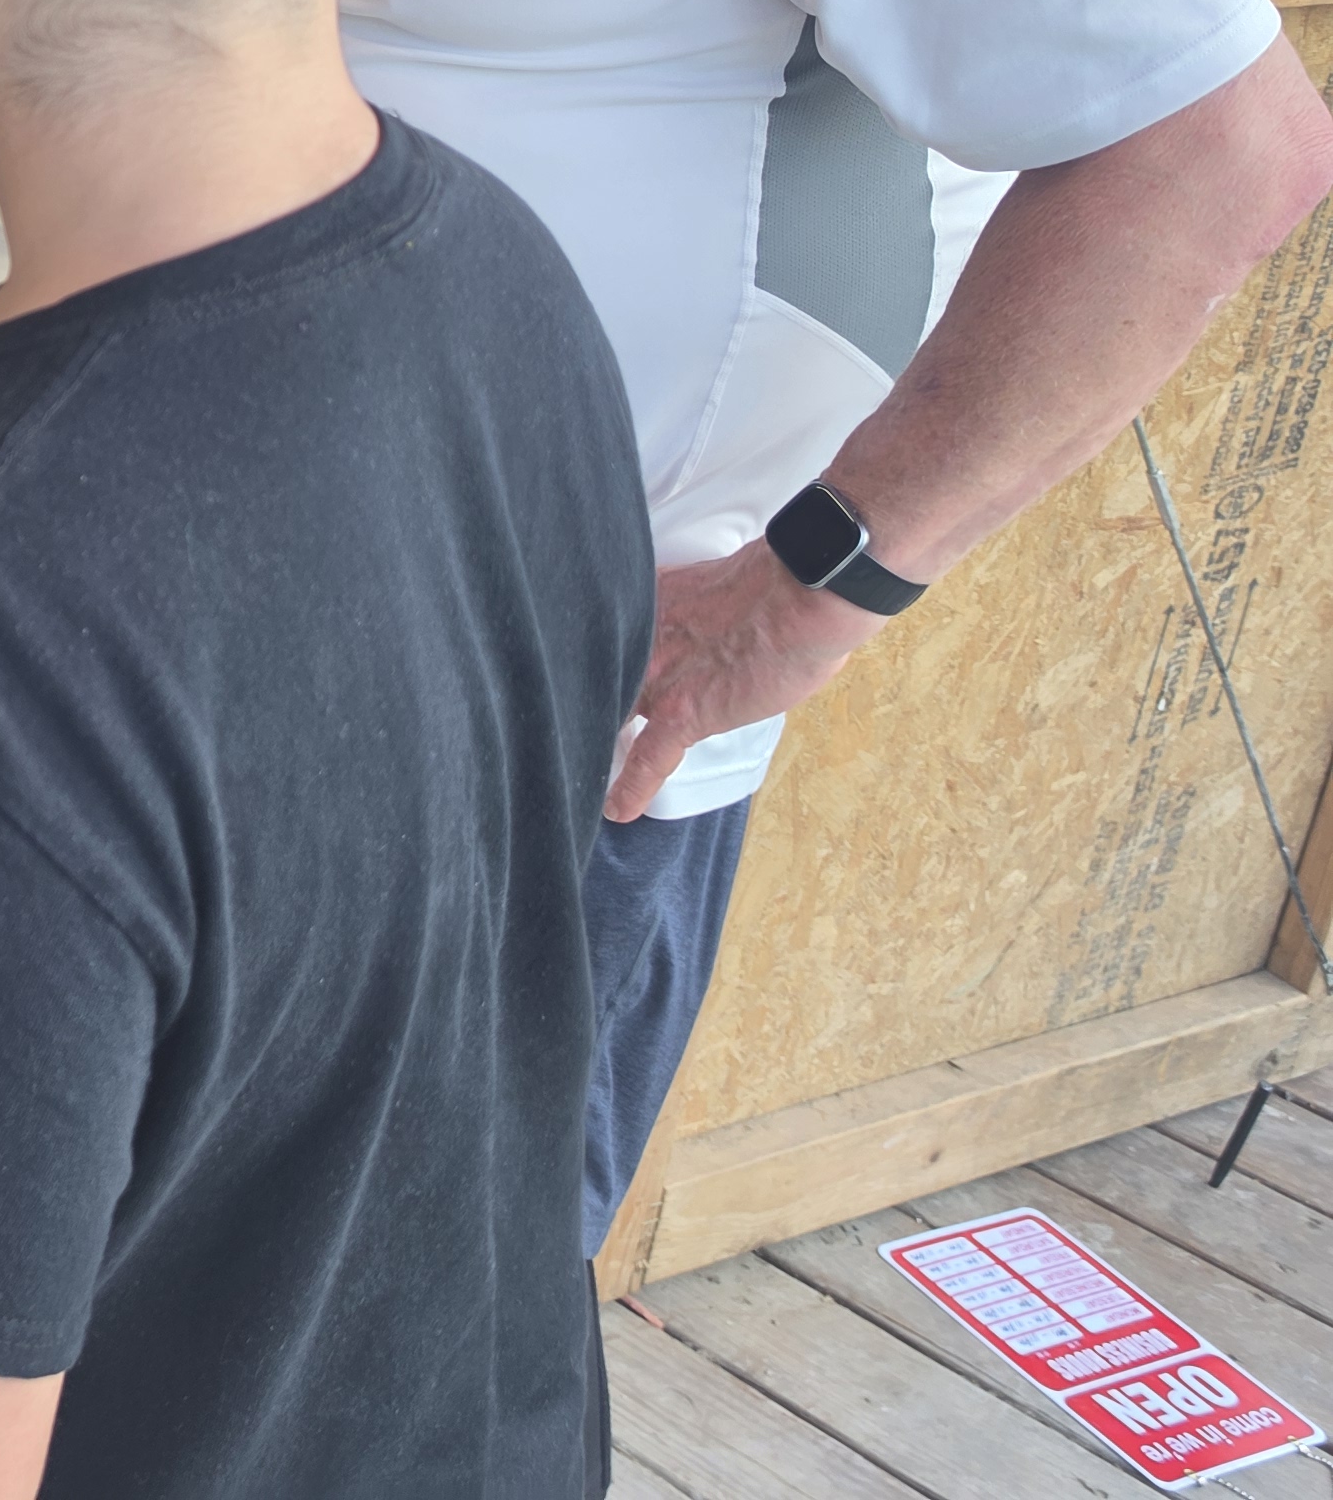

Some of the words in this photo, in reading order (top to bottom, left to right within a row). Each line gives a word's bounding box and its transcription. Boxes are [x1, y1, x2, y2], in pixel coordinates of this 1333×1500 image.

[1047, 1344, 1106, 1382] HOURS
[1105, 1328, 1179, 1369] BUSINESS
[1091, 1364, 1240, 1436] OPEN
[1195, 1425, 1221, 1447] in
[1226, 1405, 1285, 1438] come
[1140, 1434, 1193, 1464] we're
